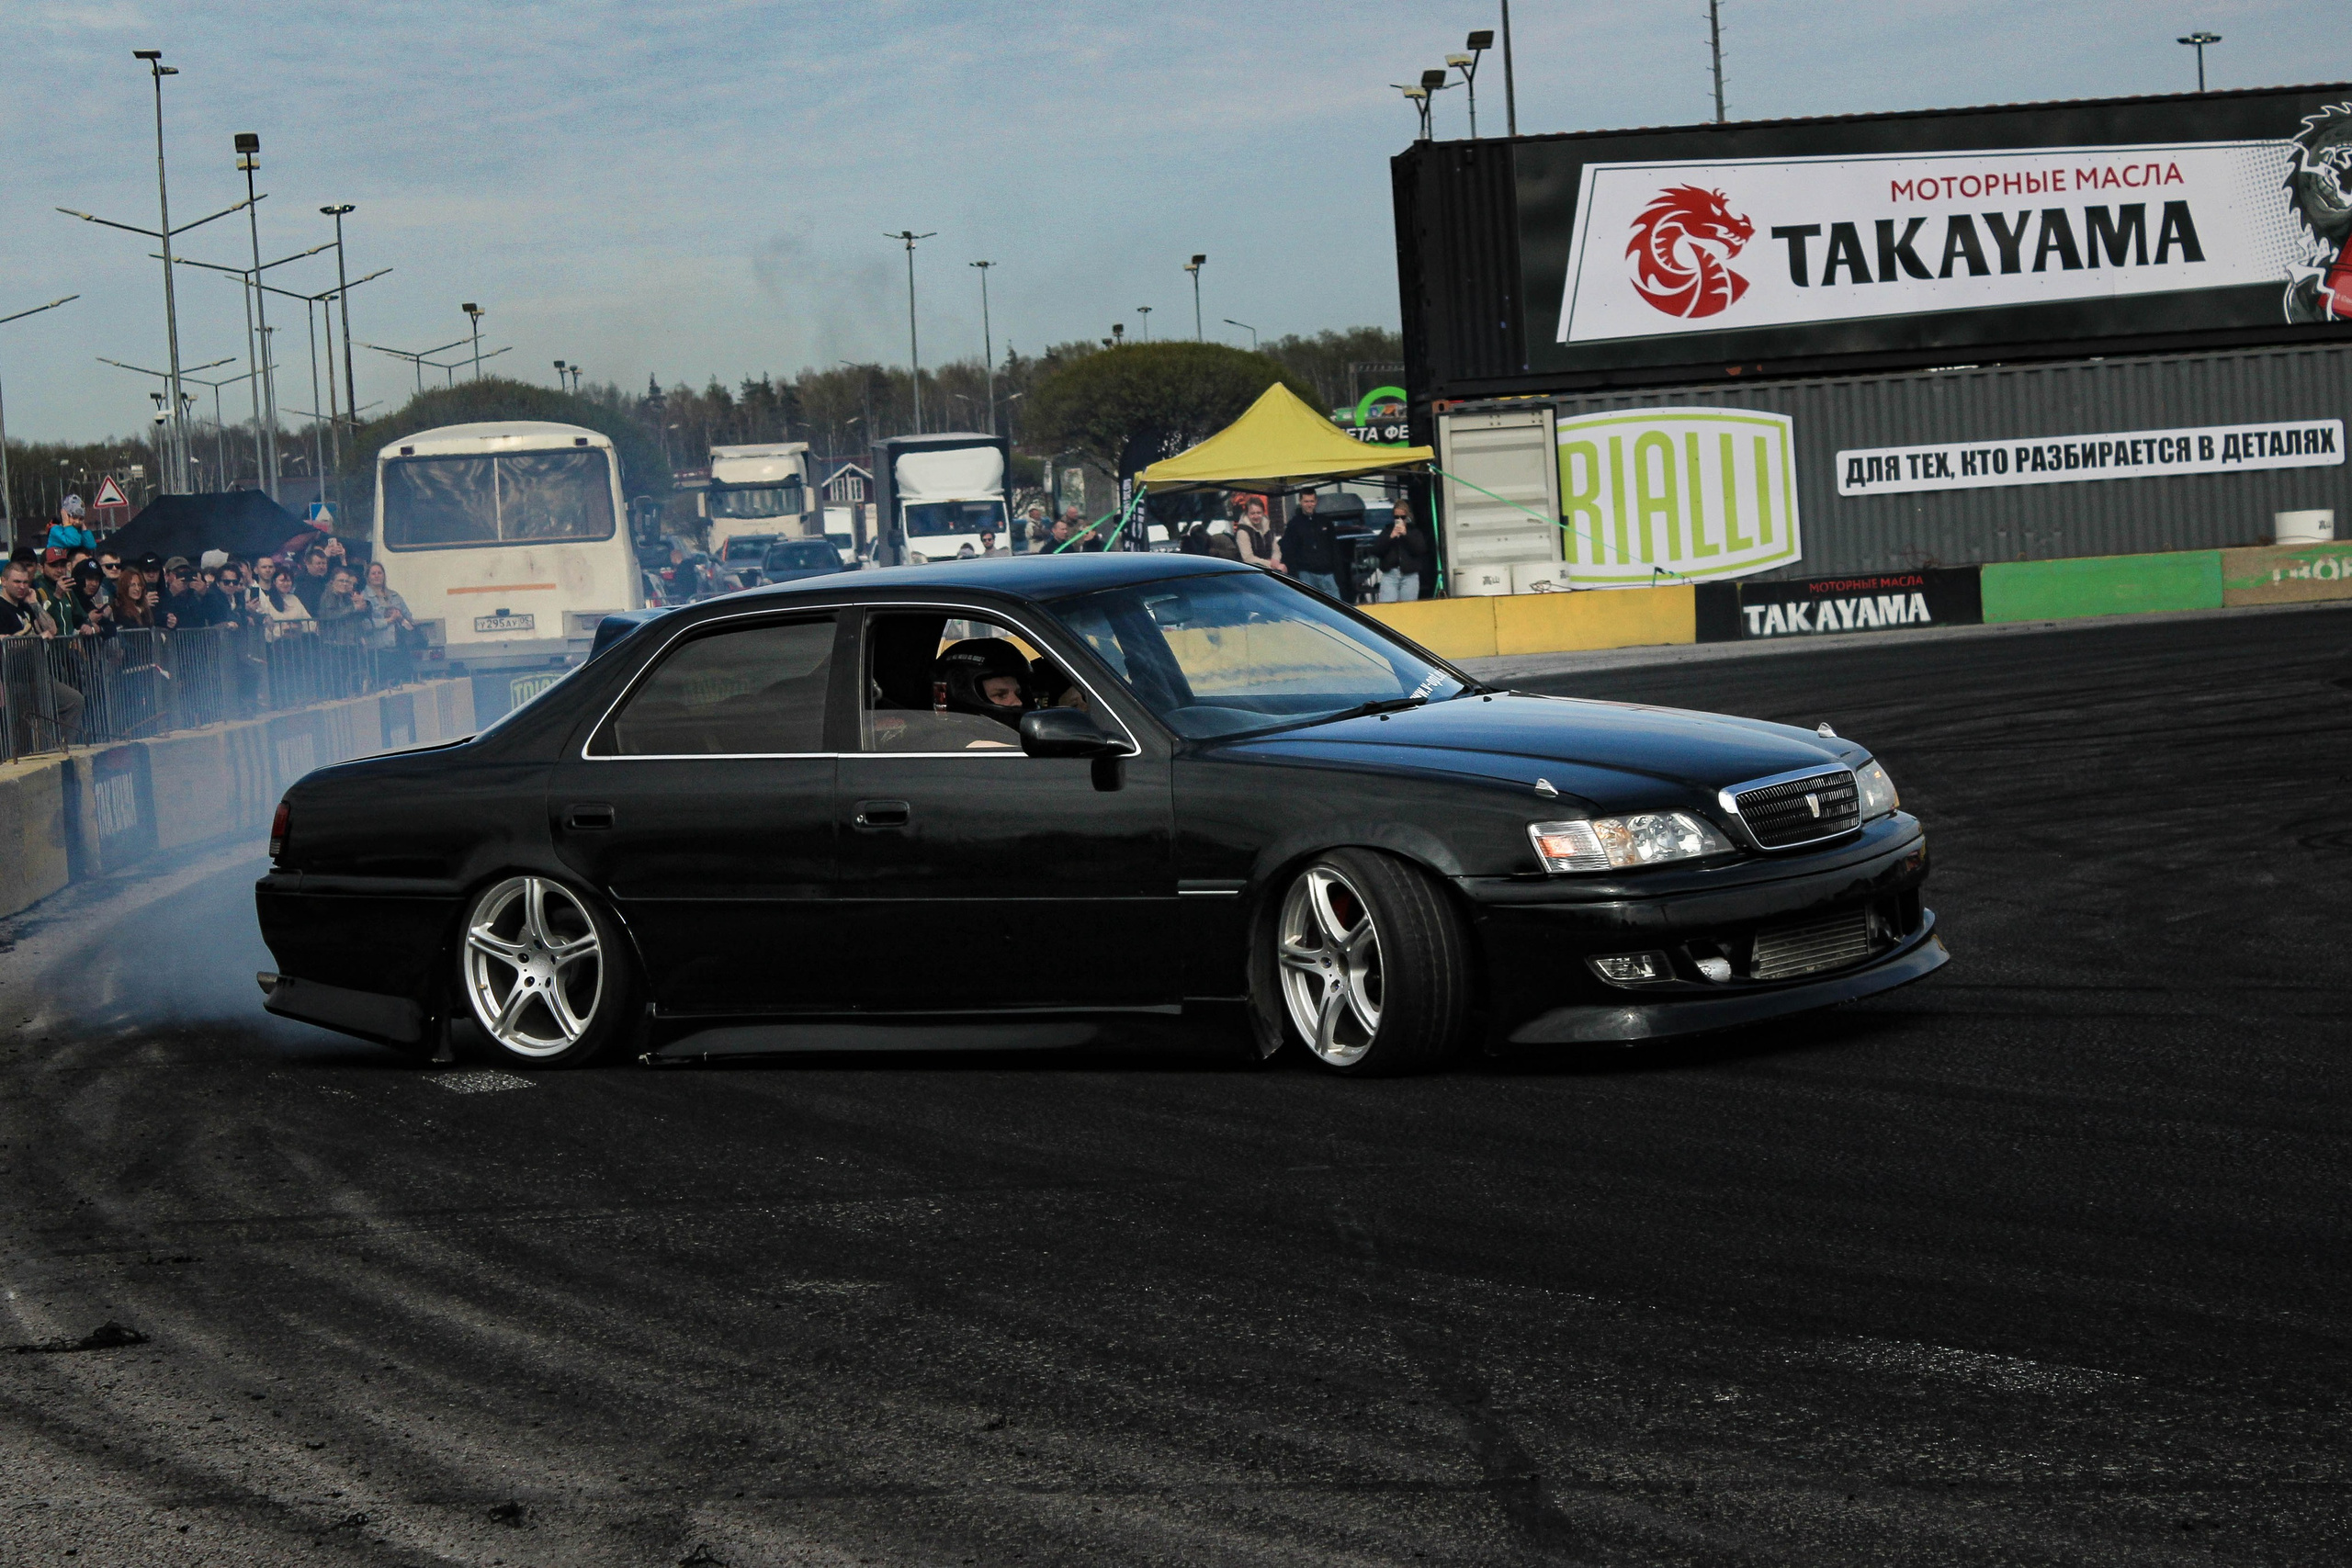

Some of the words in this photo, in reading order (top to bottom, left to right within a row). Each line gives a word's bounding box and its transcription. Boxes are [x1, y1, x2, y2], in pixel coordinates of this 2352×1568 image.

[1890, 168, 2066, 203] МОТОРНЫЕ
[2075, 162, 2185, 192] МАСЛА
[1771, 199, 2207, 288] TAKAYAMA
[1846, 456, 1901, 488] ДЛЯ
[1907, 450, 1955, 480] ТЕХ,
[1961, 446, 2009, 476] КТО
[2015, 435, 2192, 472] РАЗБИРАЕТСЯ
[2199, 434, 2215, 460] В
[2222, 427, 2336, 463] ДЕТАЛЯХ
[1558, 430, 1773, 566] RIALLI
[1809, 578, 1878, 593] МОТОРНЫЕ
[1880, 575, 1924, 588] МАСЛА
[1743, 592, 1932, 637] TAKAYAMA
